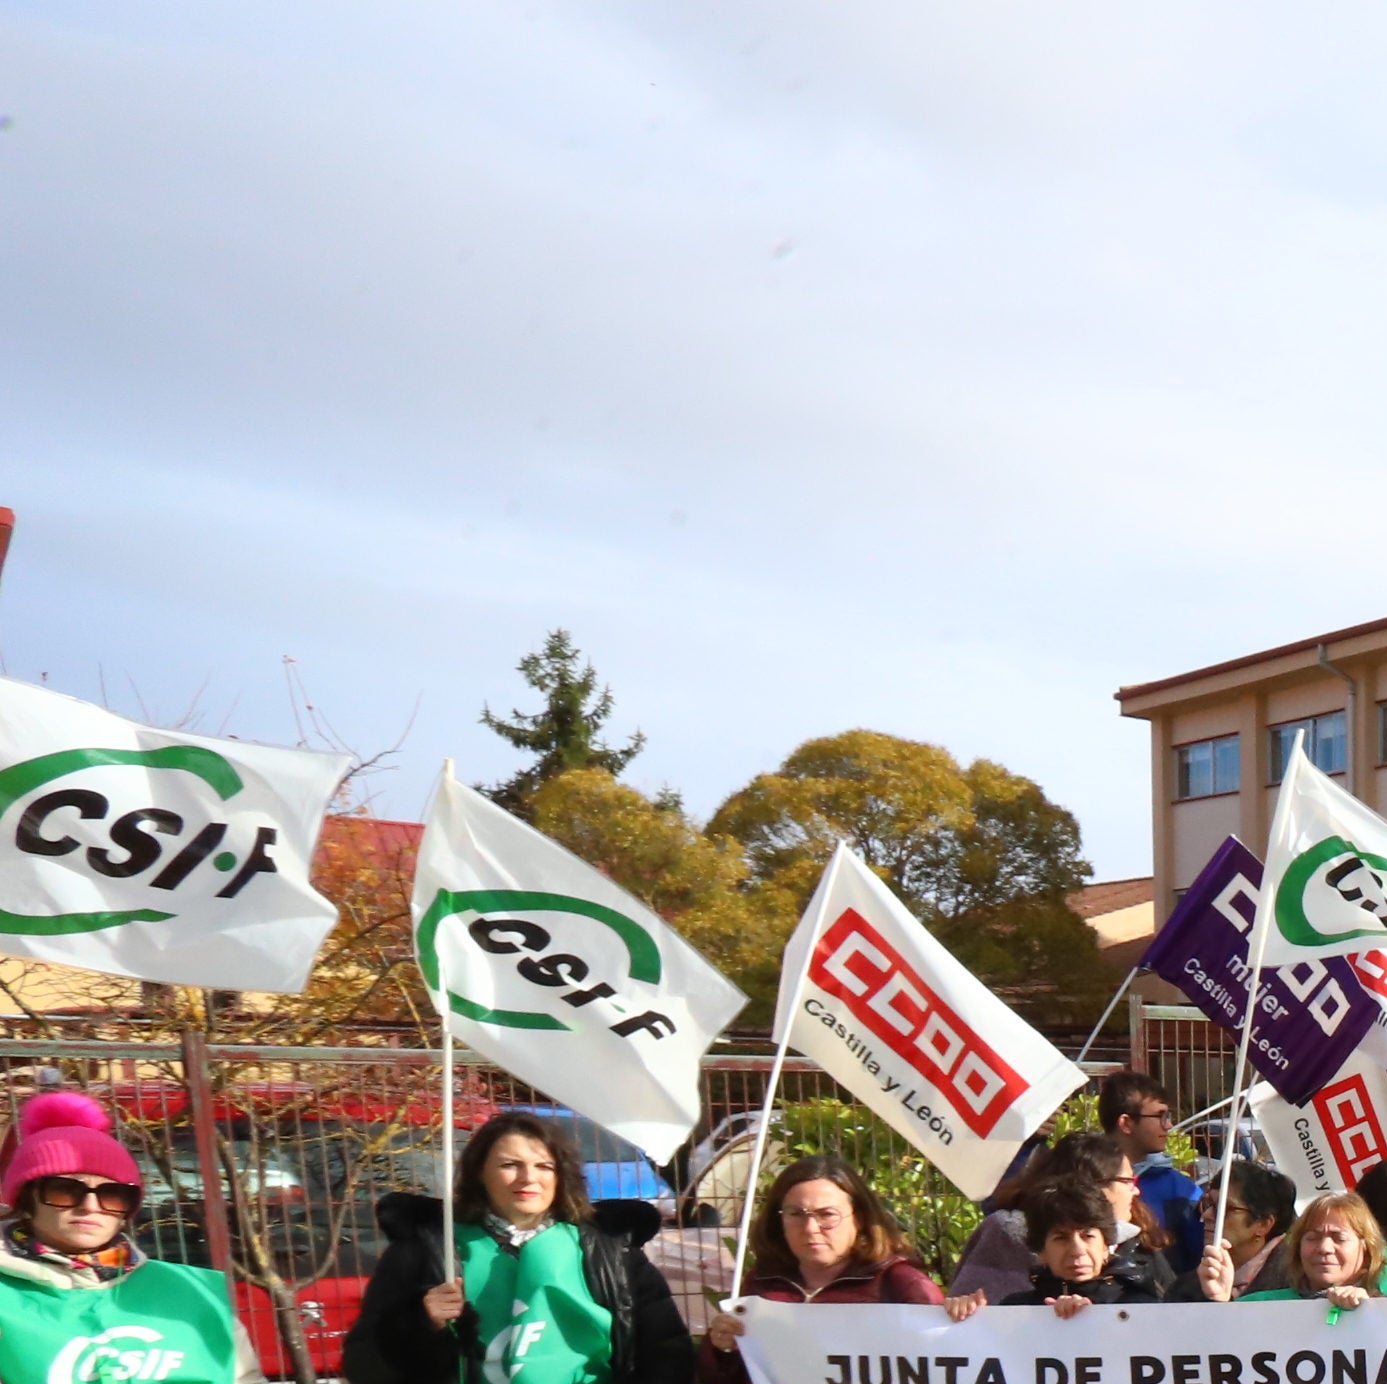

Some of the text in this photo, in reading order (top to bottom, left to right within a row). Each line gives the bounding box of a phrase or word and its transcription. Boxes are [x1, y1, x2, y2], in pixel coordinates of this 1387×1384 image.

[822, 930, 1006, 1116] CCOO
[1183, 957, 1238, 1018] Castilla
[1249, 1025, 1291, 1071] León
[804, 998, 954, 1146] Castilla y León
[1294, 1117, 1326, 1179] Castilla
[80, 1344, 184, 1382] CSIF
